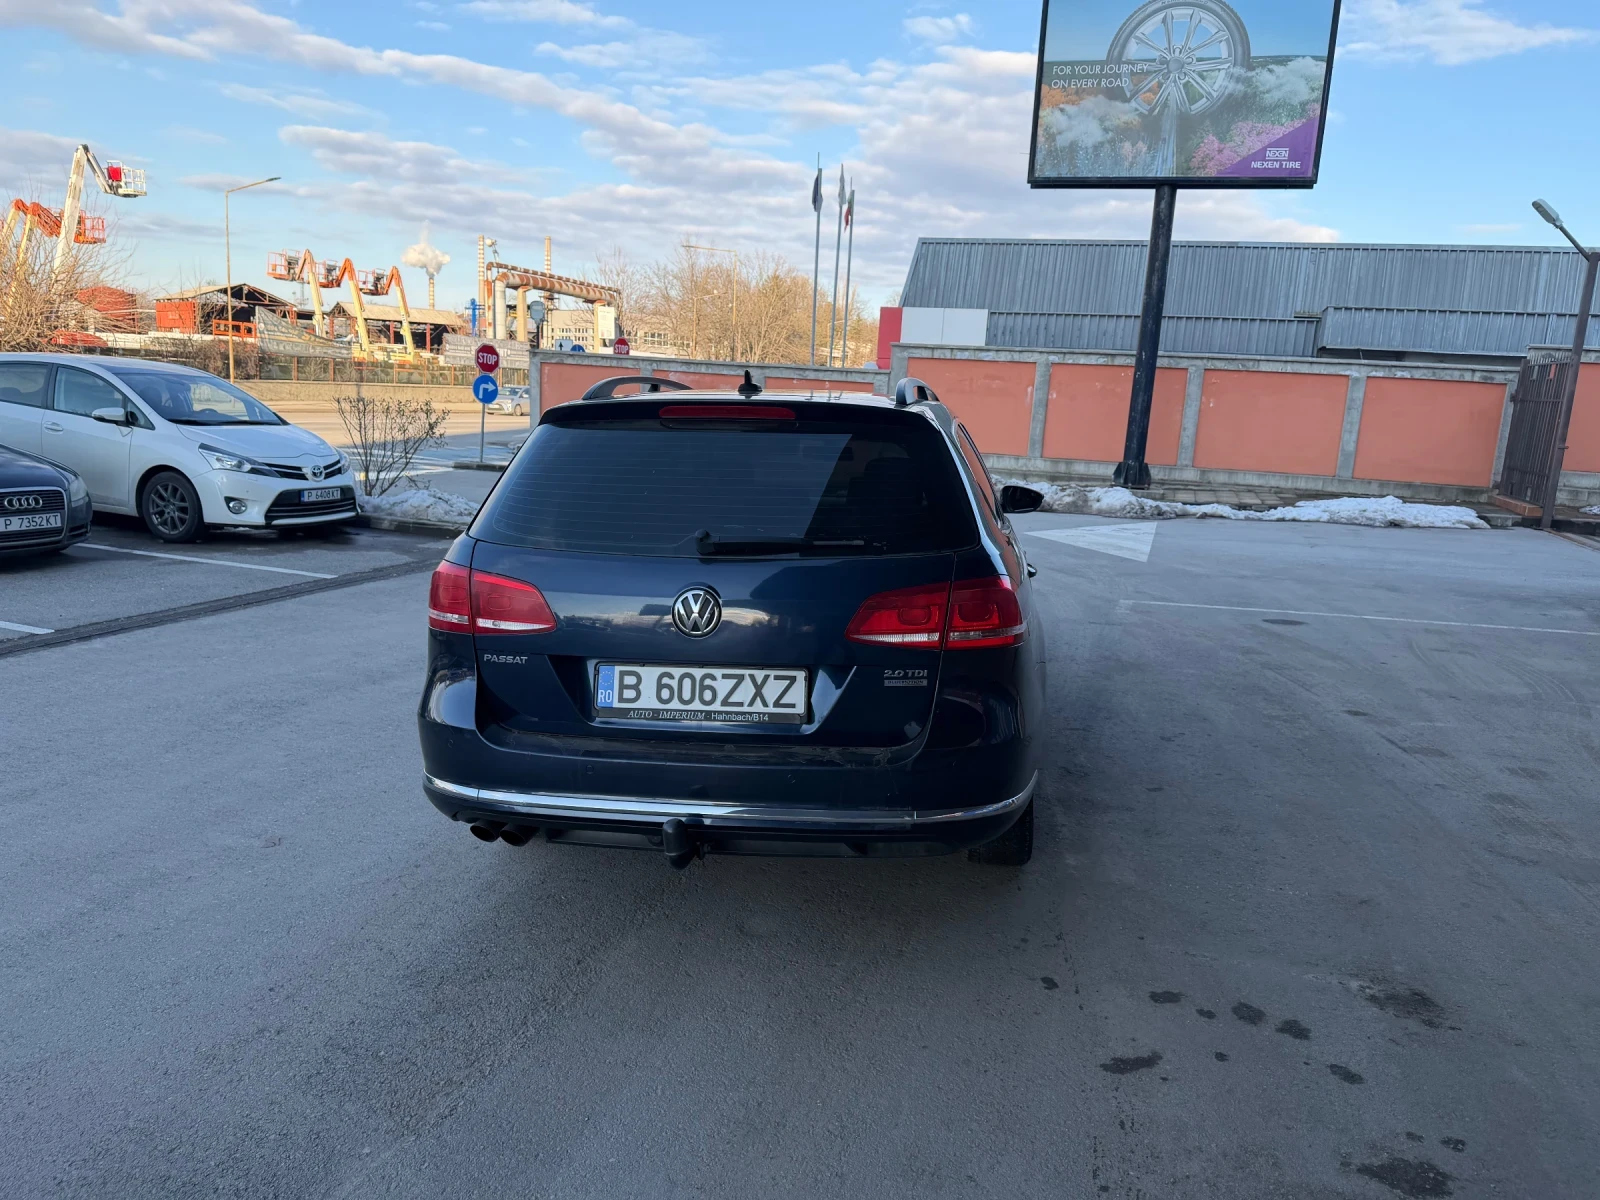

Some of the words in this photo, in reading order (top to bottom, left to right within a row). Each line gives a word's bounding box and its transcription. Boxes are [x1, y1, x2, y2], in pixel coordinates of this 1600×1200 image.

[1052, 66, 1072, 74] FOR
[1074, 65, 1101, 74] YOUR
[1102, 64, 1149, 74] JOURNEY
[1051, 80, 1068, 88] ON
[1070, 78, 1100, 88] EVERY
[1100, 78, 1129, 88] ROAD
[614, 344, 628, 354] STOP
[478, 352, 498, 365] STOP
[307, 492, 312, 500] P
[4, 518, 12, 530] P
[18, 514, 58, 528] 7352KT
[484, 654, 528, 664] PASSAT
[884, 670, 904, 678] 2.0
[618, 670, 642, 704] B
[655, 672, 797, 708] 606ZXZ
[598, 690, 612, 702] RO
[628, 710, 652, 718] AUTO
[659, 711, 705, 720] IMPERIUM
[712, 712, 769, 722] Hahnbach/B14
